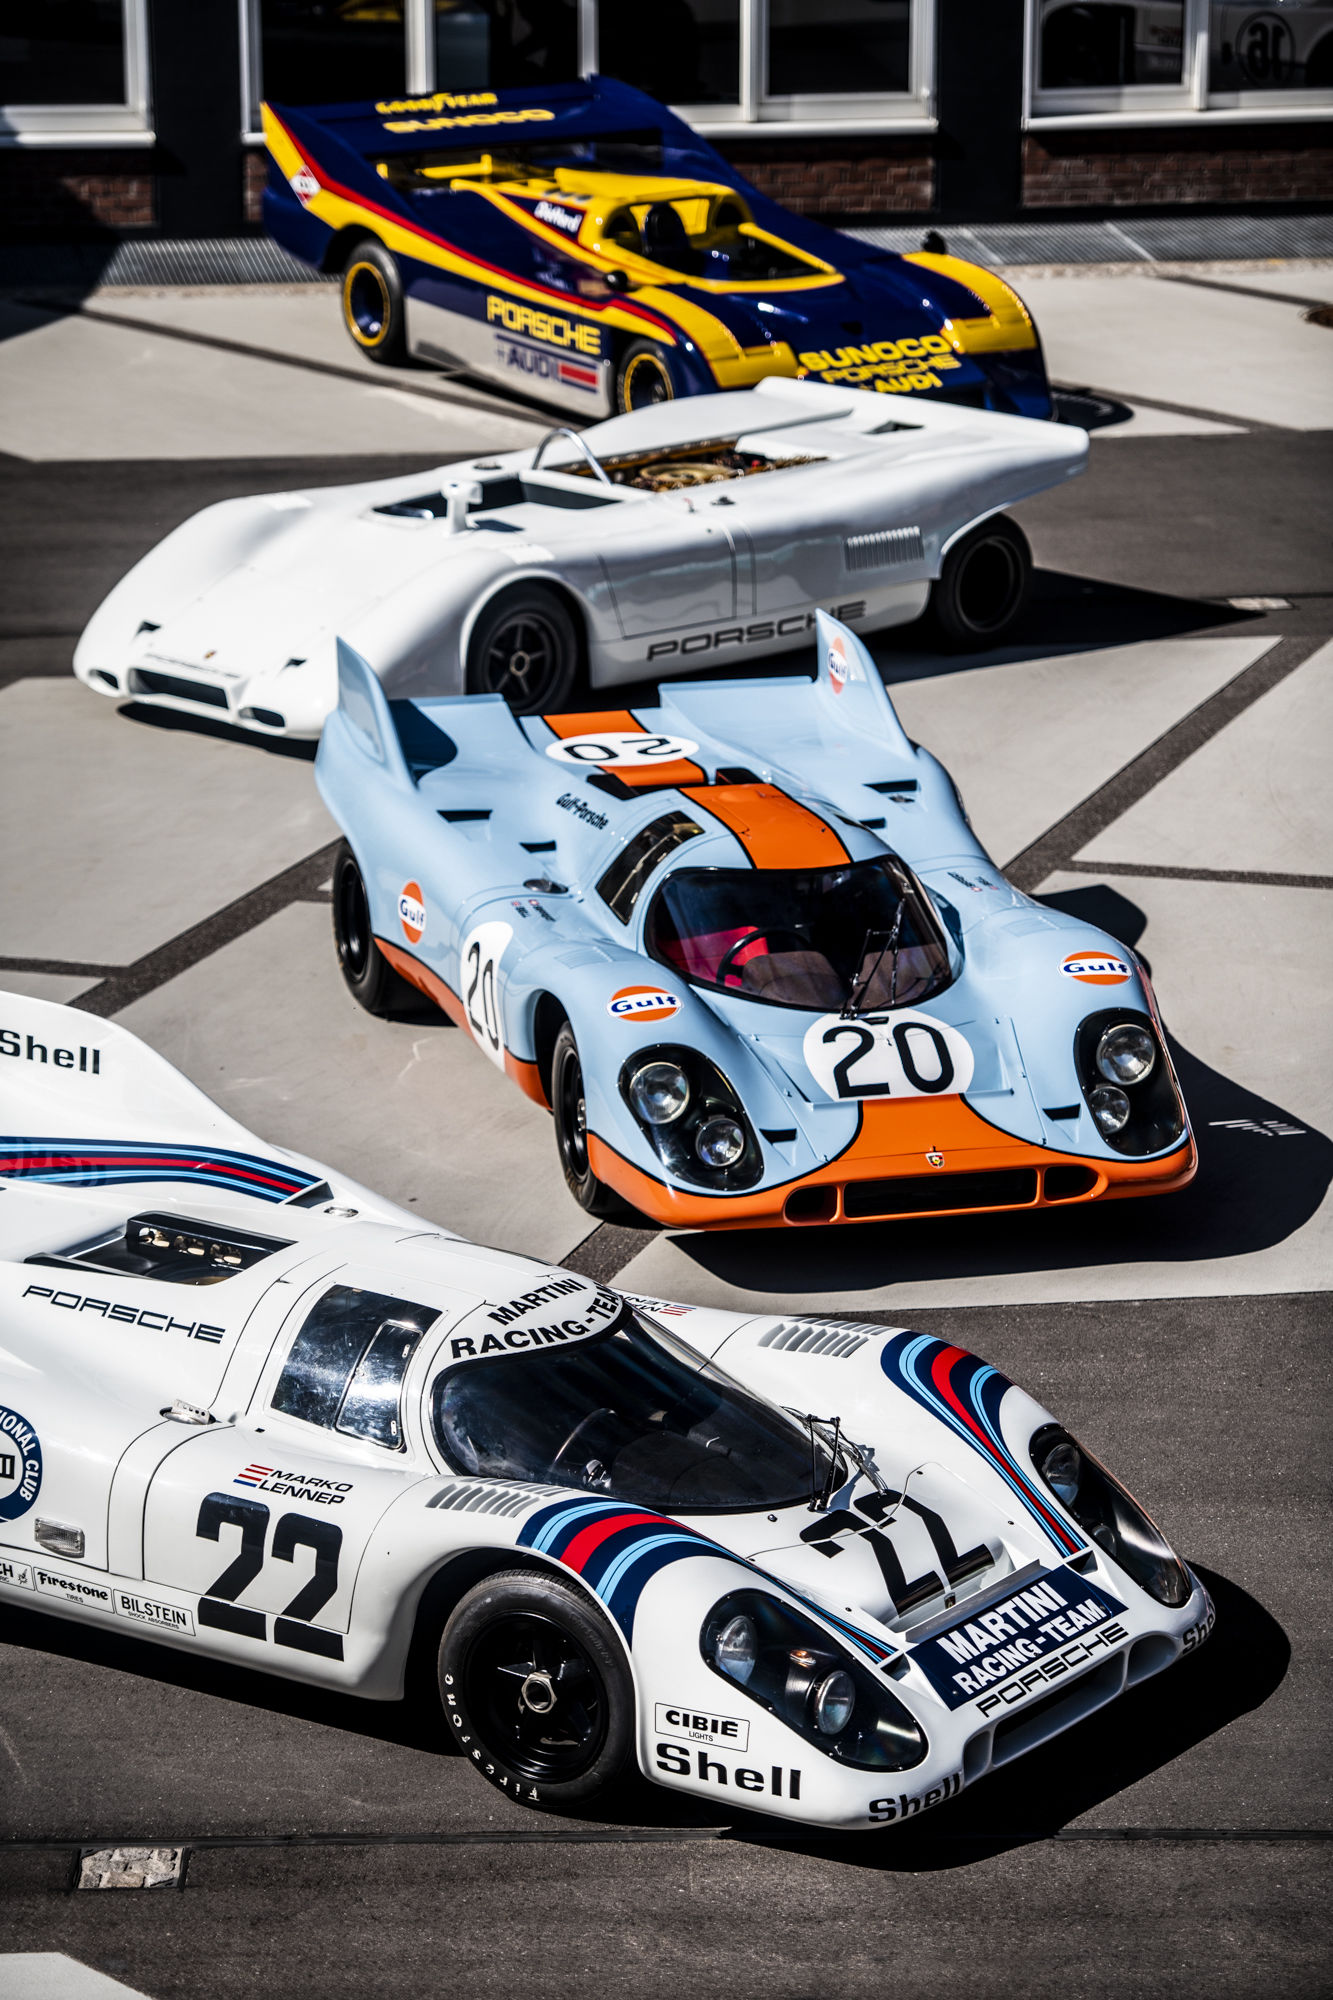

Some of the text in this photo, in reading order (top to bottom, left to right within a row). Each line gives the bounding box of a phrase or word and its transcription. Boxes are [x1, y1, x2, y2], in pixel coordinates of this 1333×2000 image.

[487, 295, 601, 355] PORSCHE
[798, 335, 952, 371] SUNOCO
[820, 353, 962, 383] PORSCHE
[563, 738, 682, 761] 20
[400, 898, 425, 927] Gulf
[1063, 961, 1128, 974] Gulf
[468, 941, 499, 1051] 20
[611, 996, 677, 1013] Gulf
[0, 1028, 100, 1075] Shell
[822, 1021, 955, 1099] 20
[22, 1285, 226, 1345] PORSCHE
[487, 1278, 589, 1326] MARTINI
[19, 1459, 40, 1502] CLUB
[258, 1479, 346, 1505] LENNEP
[270, 1470, 354, 1493] MARKO
[800, 1489, 996, 1618] 22
[37, 1571, 109, 1601] Firestone
[195, 1491, 345, 1662] 22
[121, 1595, 187, 1627] BILSTEIN
[936, 1580, 1069, 1665] MARTINI
[975, 1622, 1130, 1719] PORSCHE
[688, 1730, 715, 1743] LIGHTS
[655, 1742, 803, 1801] Shell
[868, 1771, 962, 1823] Shell
